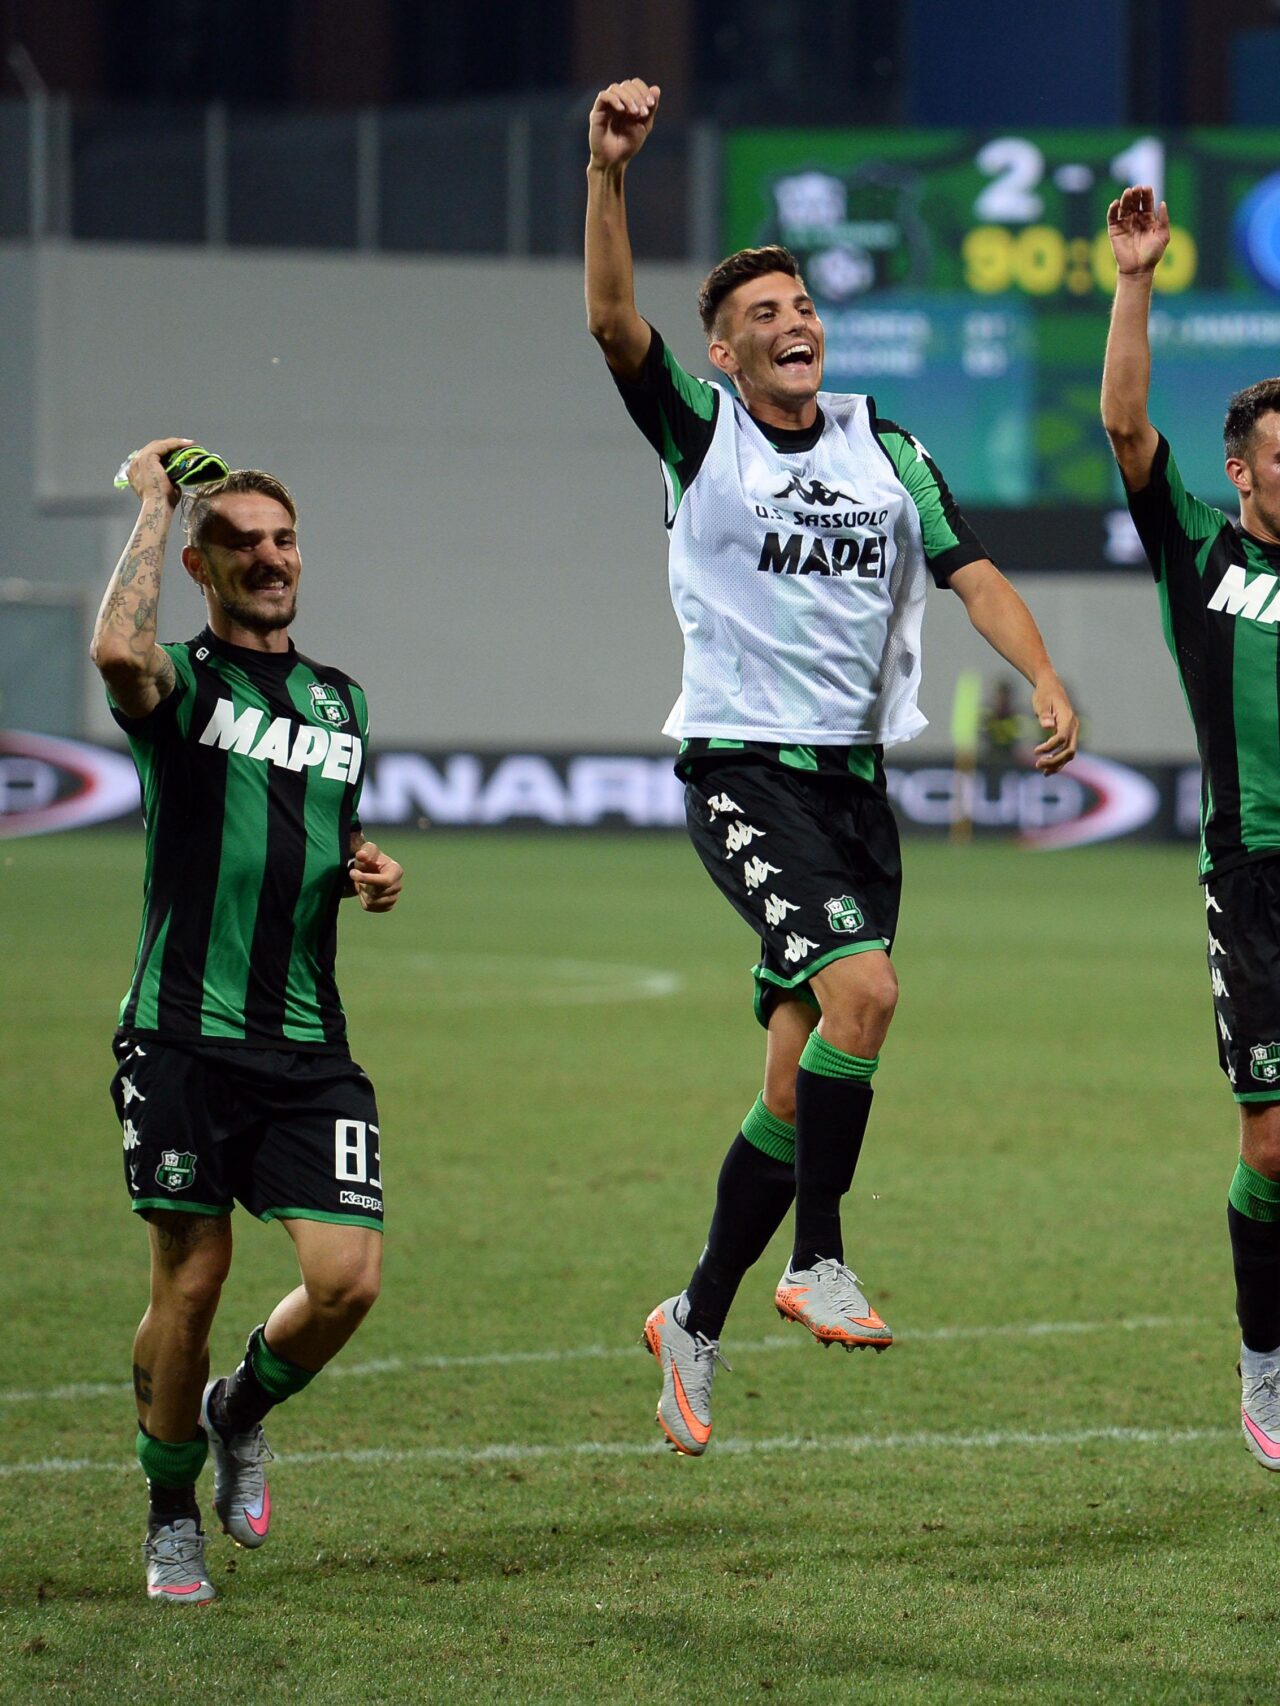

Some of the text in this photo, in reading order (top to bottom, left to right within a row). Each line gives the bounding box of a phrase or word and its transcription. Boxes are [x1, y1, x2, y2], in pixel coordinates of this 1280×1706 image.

[793, 509, 888, 528] SASSUOLO
[757, 532, 888, 579] MAPEI
[198, 697, 363, 785] MAPEI
